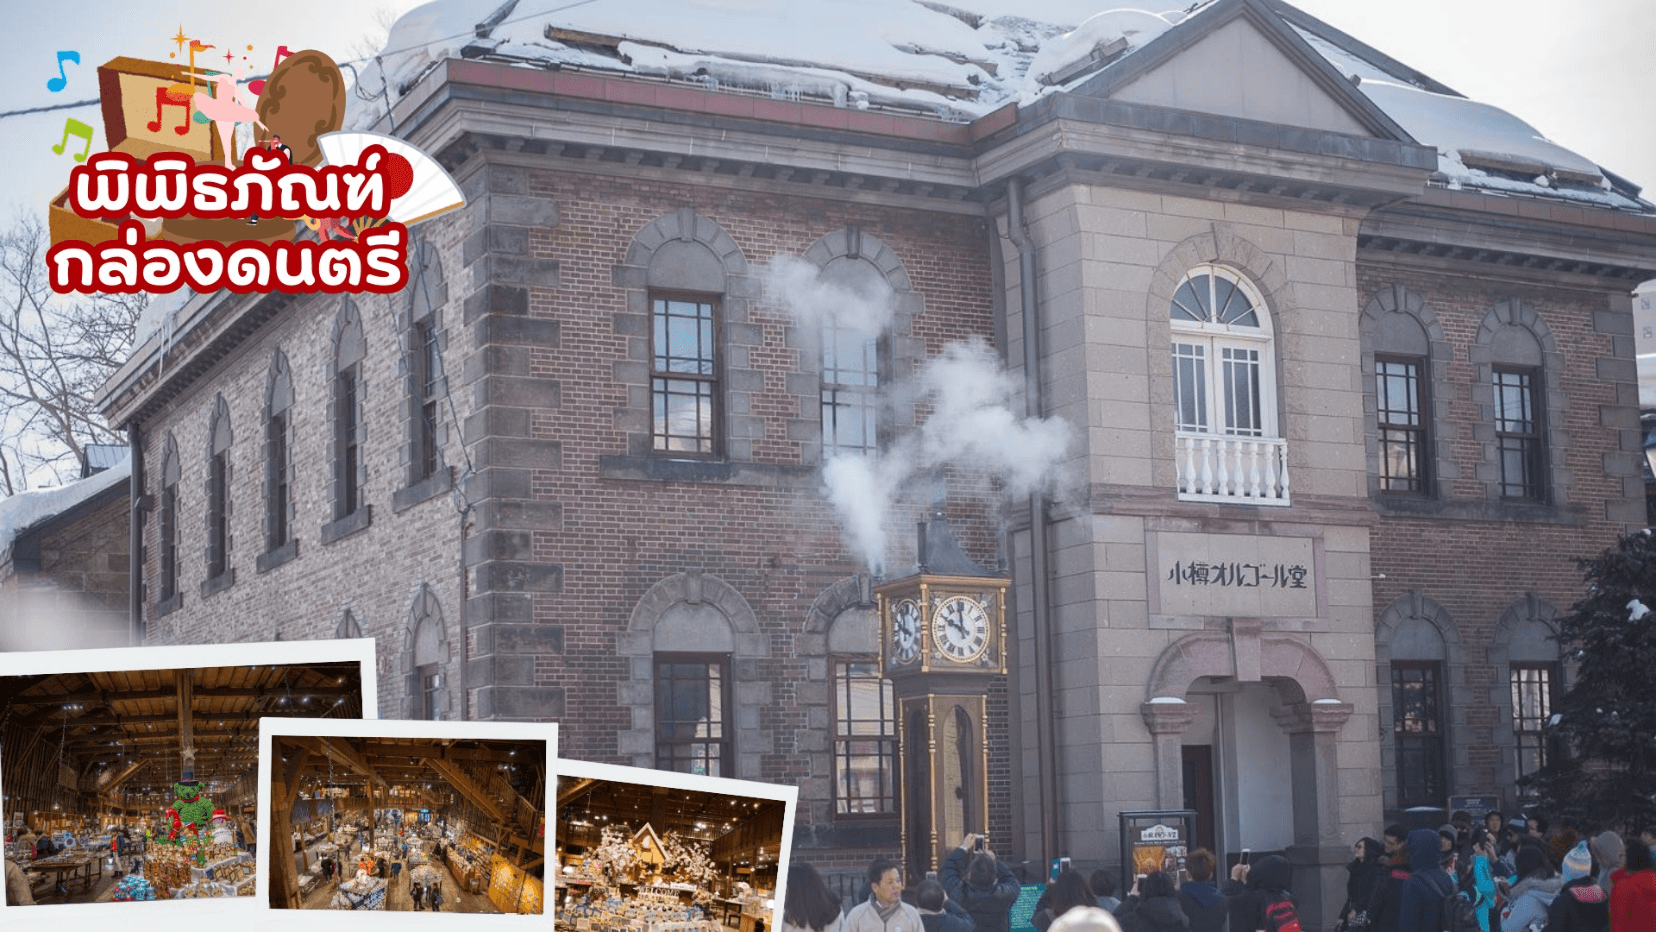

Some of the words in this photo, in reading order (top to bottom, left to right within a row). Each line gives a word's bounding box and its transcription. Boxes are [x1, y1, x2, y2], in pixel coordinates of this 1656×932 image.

[1168, 562, 1307, 589] 小樽オルゴール堂
